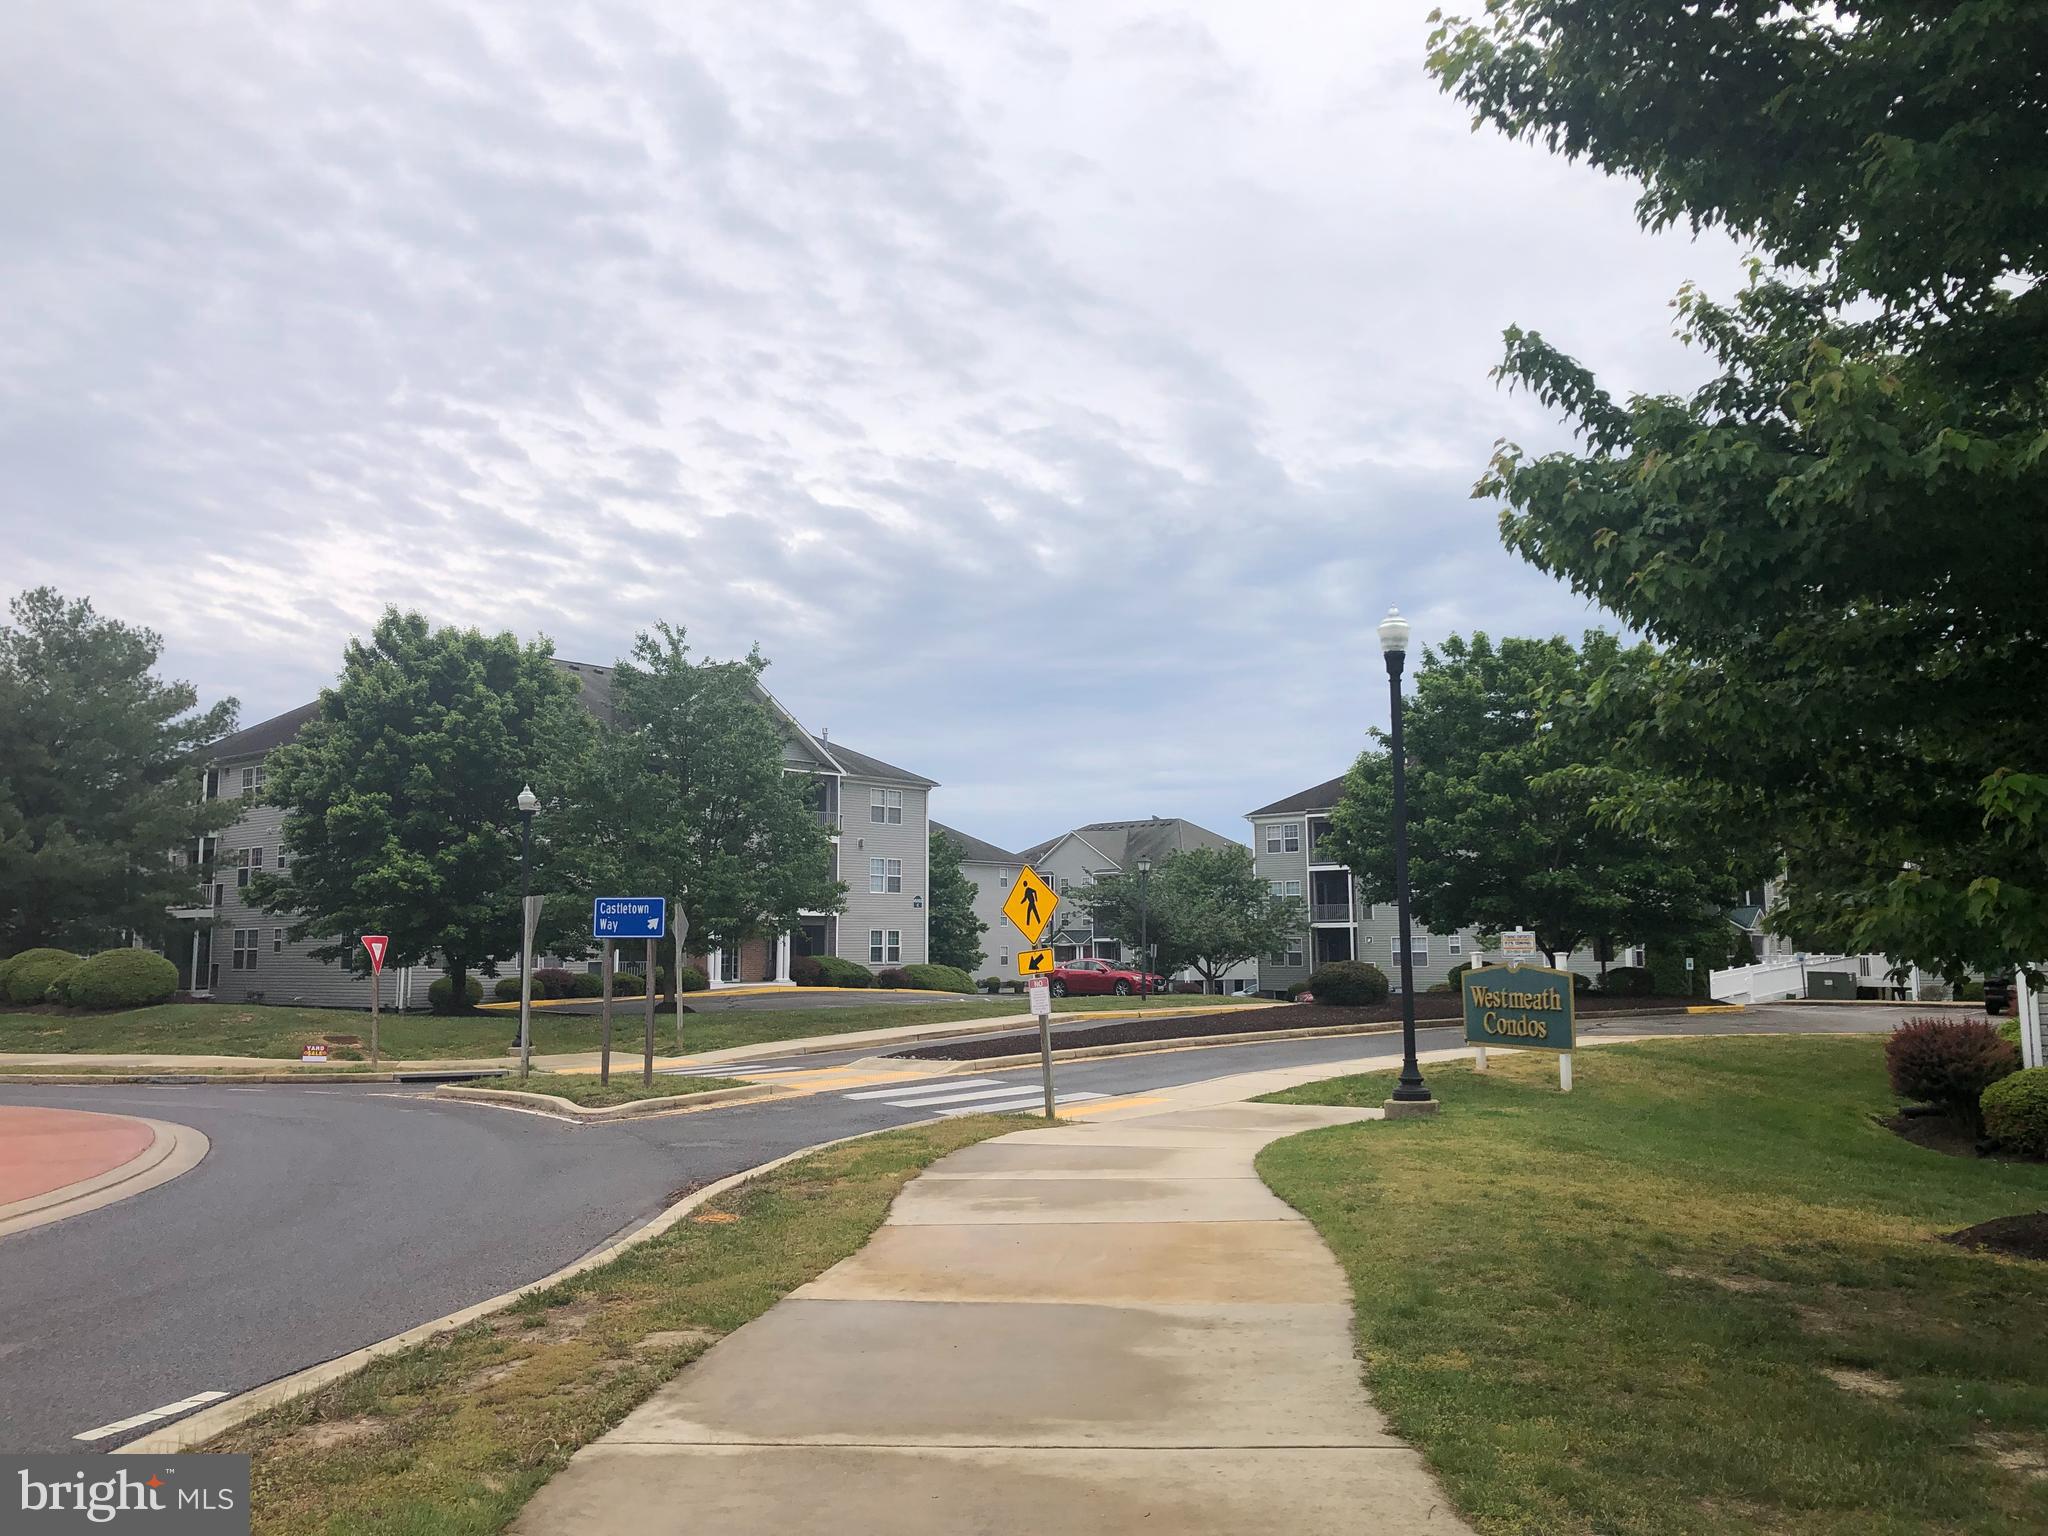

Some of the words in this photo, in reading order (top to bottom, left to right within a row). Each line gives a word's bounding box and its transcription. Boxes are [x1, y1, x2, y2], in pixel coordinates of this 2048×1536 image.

[600, 902, 649, 914] Castletown
[600, 918, 618, 933] Way
[1470, 986, 1562, 1011] Westmeath
[1483, 1011, 1548, 1039] Condos
